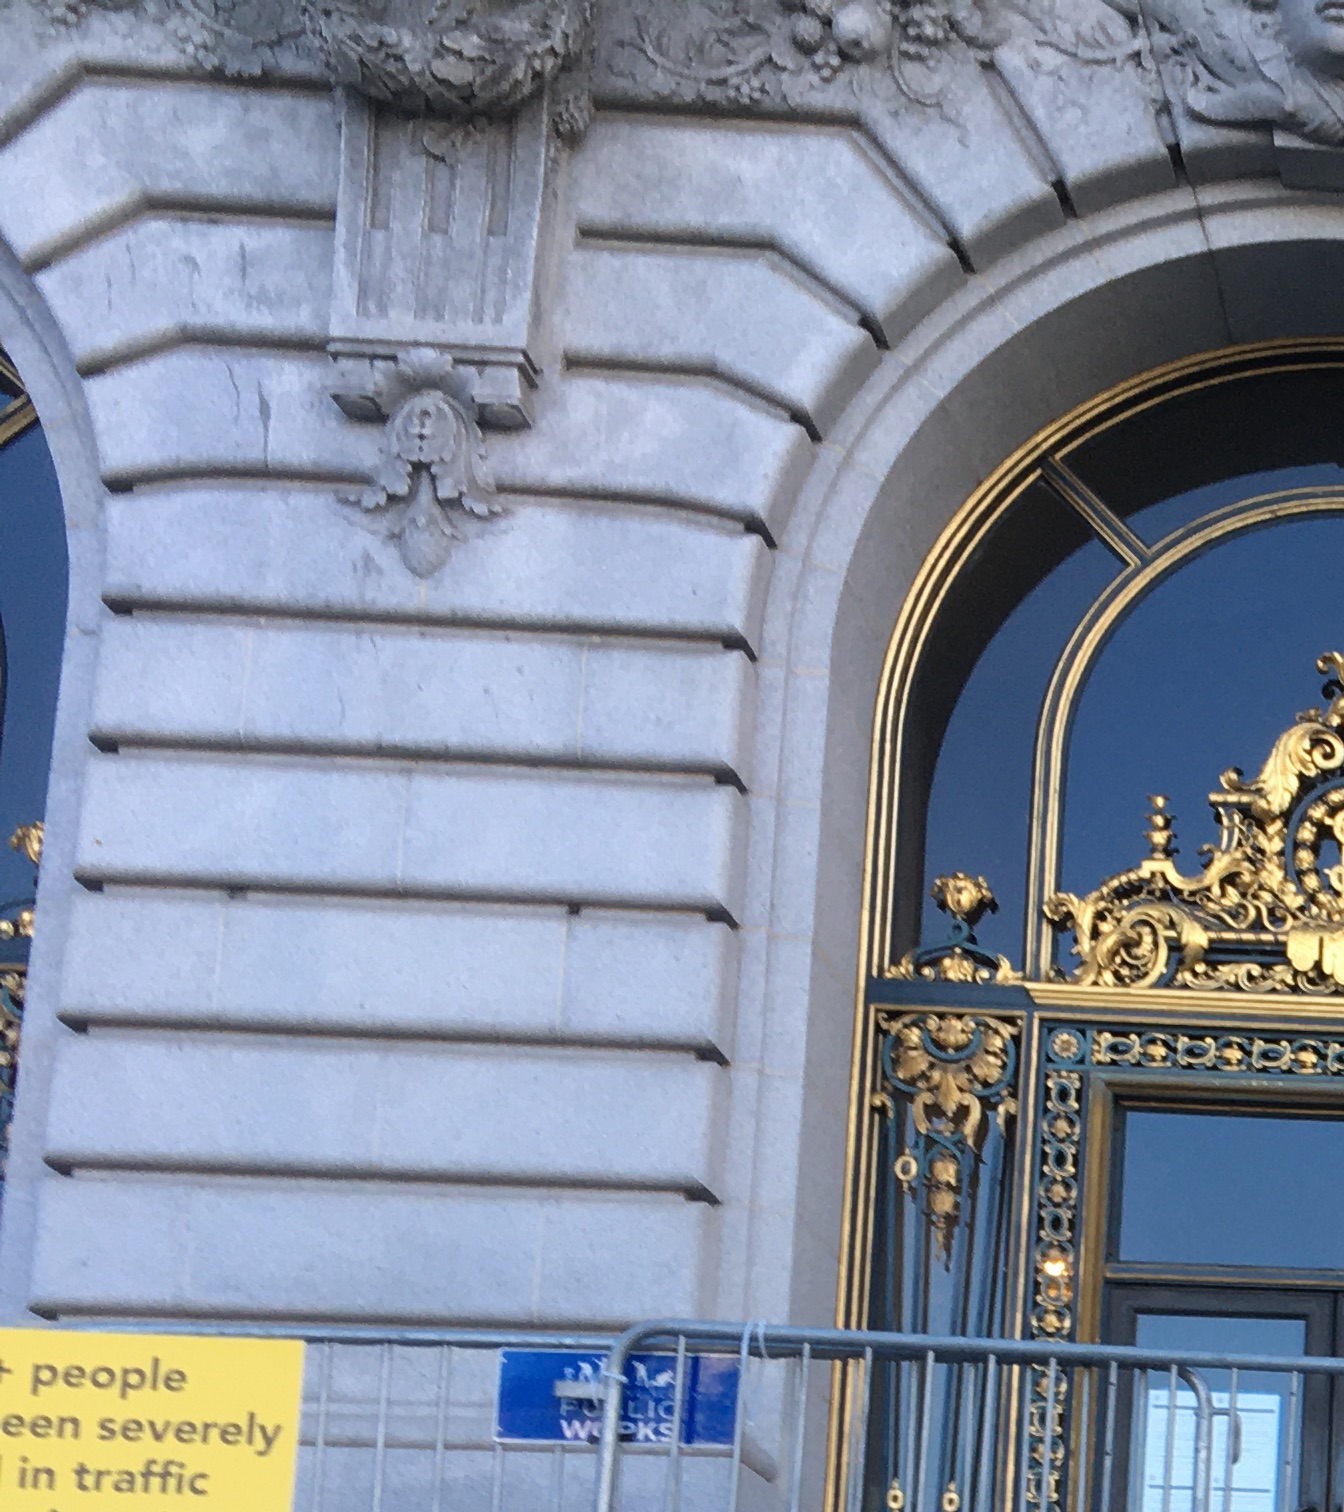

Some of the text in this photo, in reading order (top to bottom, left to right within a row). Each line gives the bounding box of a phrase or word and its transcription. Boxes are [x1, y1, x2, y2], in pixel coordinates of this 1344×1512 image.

[29, 1355, 188, 1400] people
[0, 1411, 283, 1457] een severely
[17, 1454, 211, 1496] in traffic
